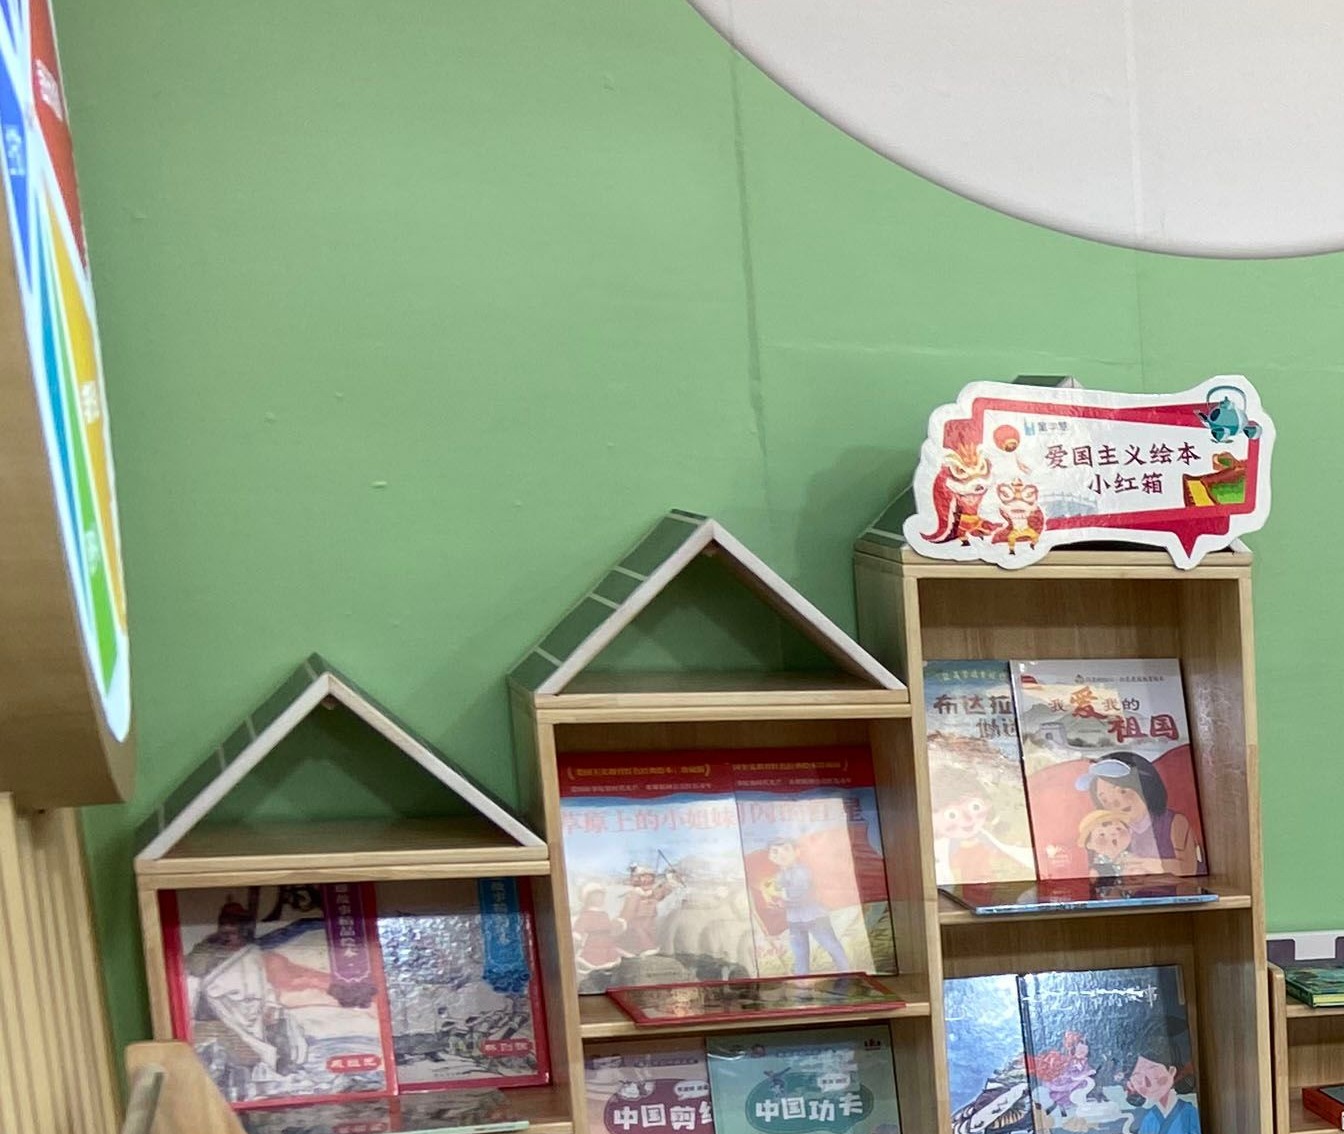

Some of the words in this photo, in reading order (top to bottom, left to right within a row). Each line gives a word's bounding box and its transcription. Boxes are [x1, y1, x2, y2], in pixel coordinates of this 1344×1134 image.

[1044, 441, 1201, 469] 爱国主义绘本
[1088, 472, 1164, 495] 小红箱
[1050, 686, 1140, 720] 我爱我的
[1107, 713, 1180, 743] 祖国
